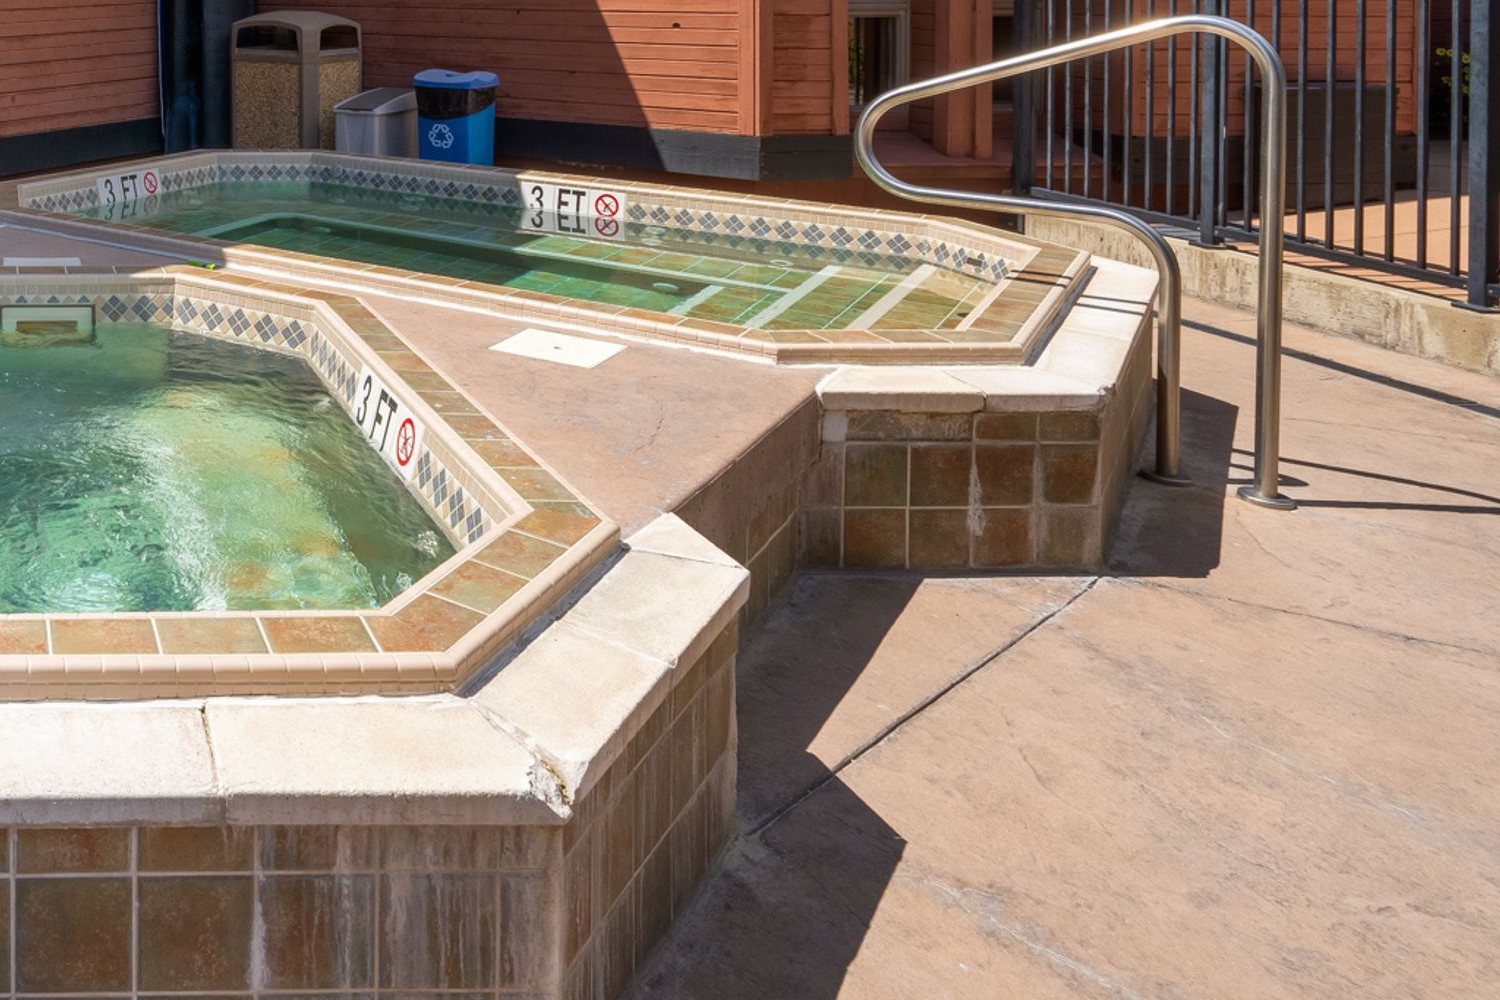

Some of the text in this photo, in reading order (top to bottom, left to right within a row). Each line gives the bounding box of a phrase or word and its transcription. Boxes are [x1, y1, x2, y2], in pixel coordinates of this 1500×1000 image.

[104, 174, 138, 203] 3 FT
[530, 185, 586, 212] 3 FT
[356, 374, 398, 453] 3 FT
